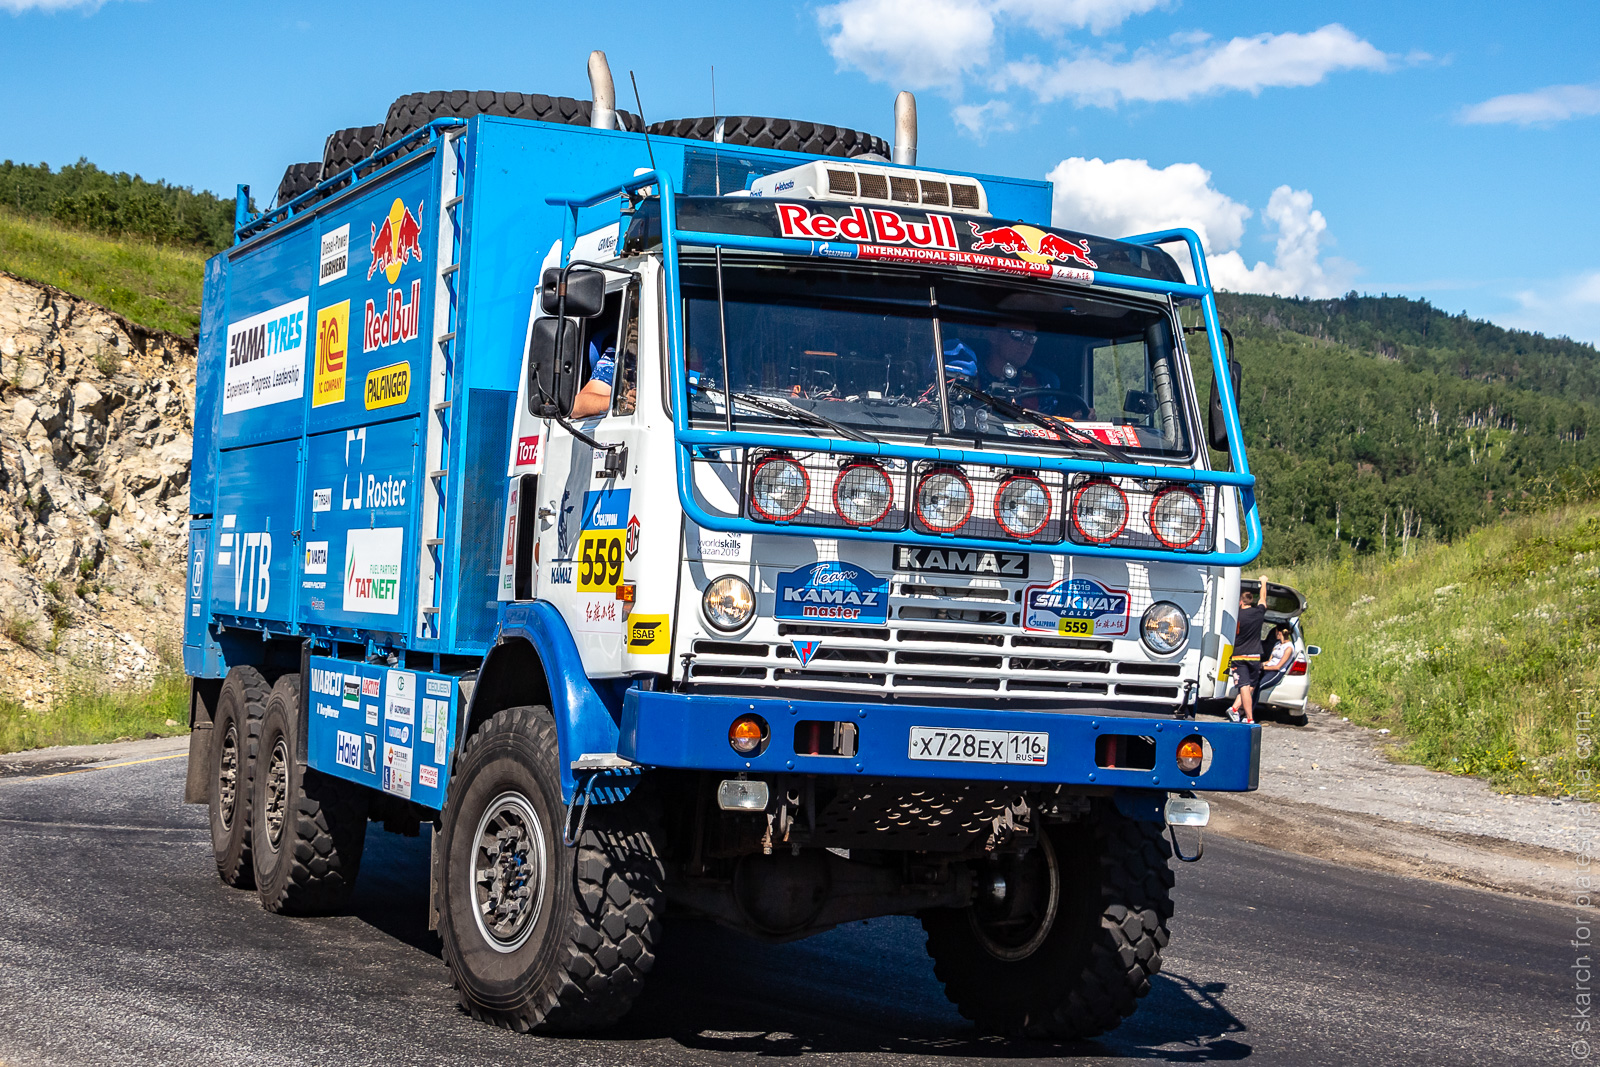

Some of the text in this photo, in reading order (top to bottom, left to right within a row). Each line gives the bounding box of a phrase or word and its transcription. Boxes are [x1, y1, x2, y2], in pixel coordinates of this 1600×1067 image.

[775, 180, 795, 194] Webasto
[775, 203, 960, 251] Red Bull
[321, 254, 347, 279] LIEBHERR
[863, 245, 1050, 272] INTERNATIONAL SILK WAY RALLY 2019
[363, 278, 421, 353] Red Bull
[324, 377, 343, 394] COMPANY
[366, 370, 408, 403] PALFINGER
[366, 473, 407, 508] Rostec
[697, 539, 741, 549] worldskills
[311, 549, 327, 565] VARTA
[581, 537, 622, 586] 559
[899, 547, 1024, 575] KAMAZ
[235, 532, 272, 613] VTB
[551, 567, 573, 585] KAMAZ
[810, 563, 858, 587] Team
[355, 577, 397, 600] TATNEFT
[783, 587, 879, 607] KAMAZ
[1069, 583, 1091, 591] 2019
[803, 605, 861, 620] master
[1034, 594, 1122, 611] SILK WAY
[632, 629, 655, 639] ESAB
[1064, 621, 1088, 633] 559
[311, 668, 342, 697] WABCO
[337, 734, 360, 767] Haier
[1009, 735, 1041, 754] 116
